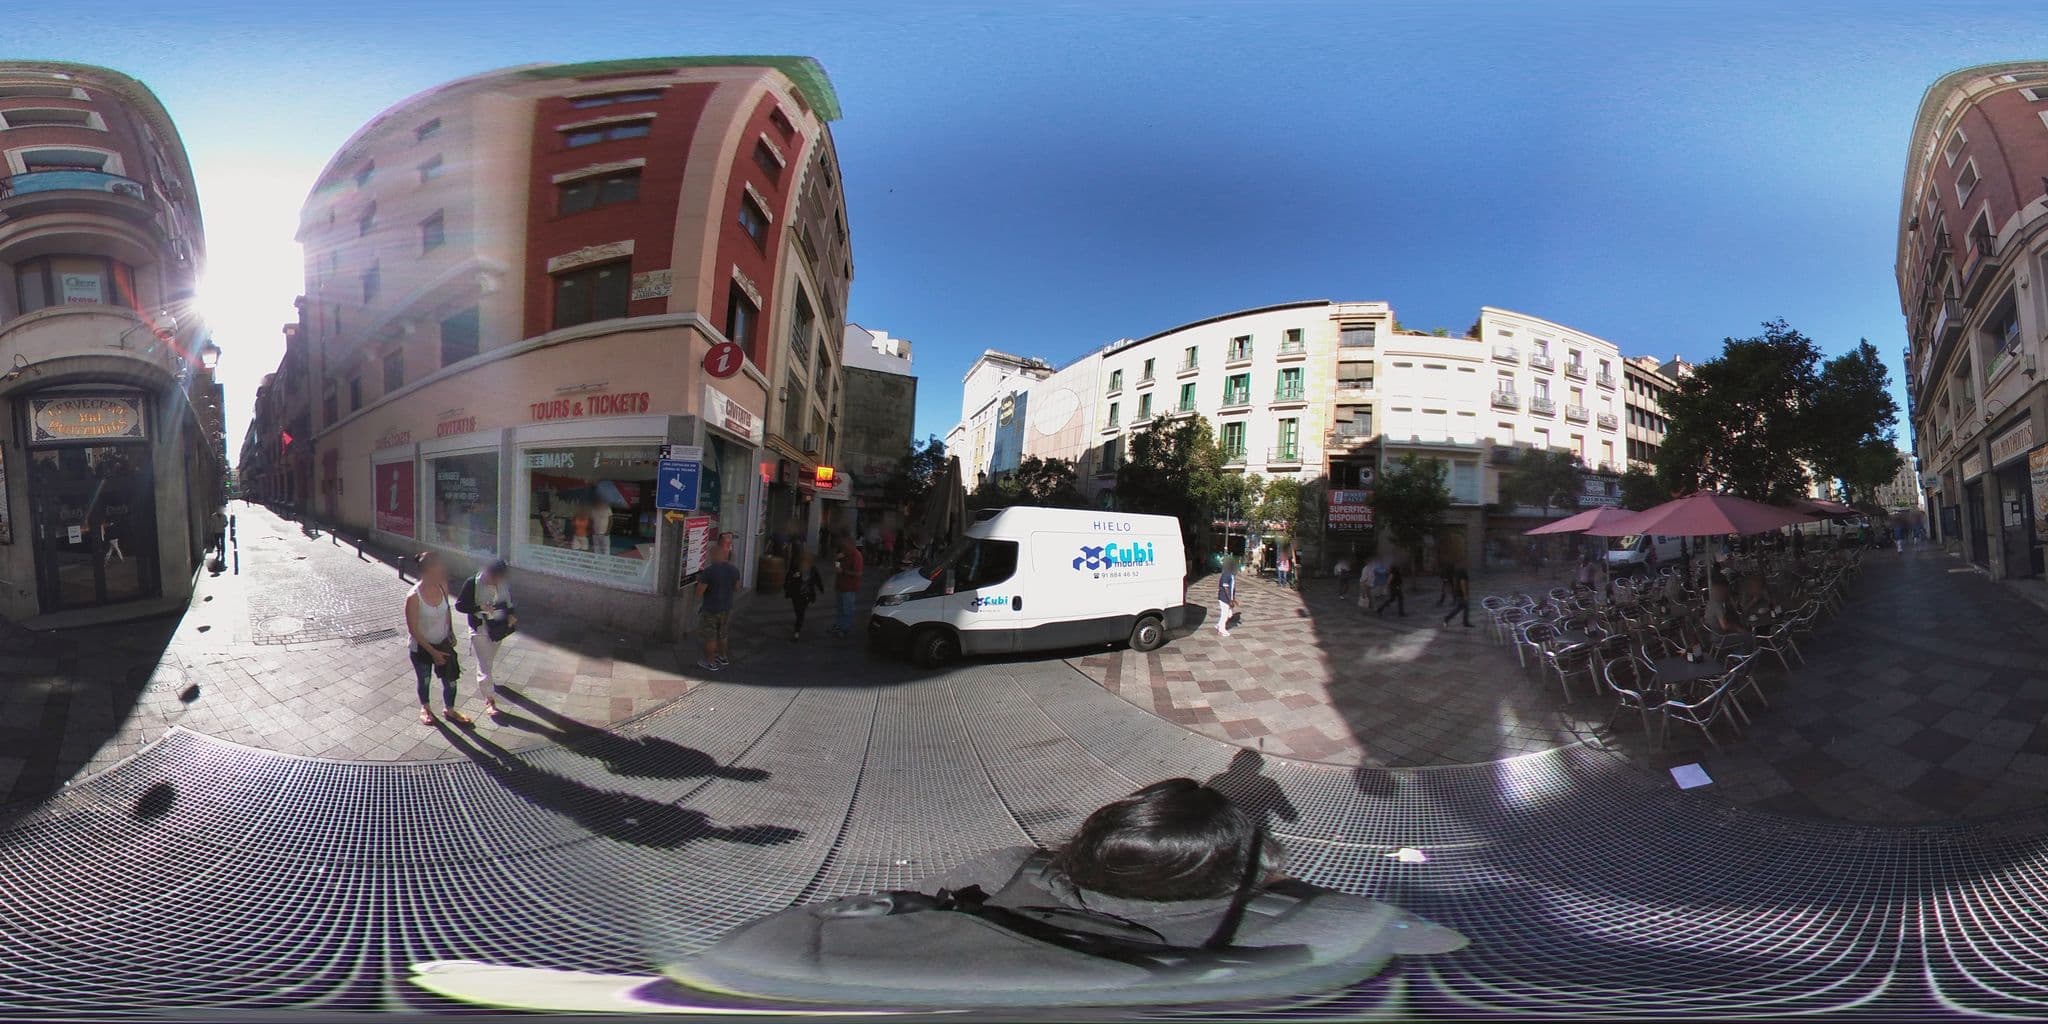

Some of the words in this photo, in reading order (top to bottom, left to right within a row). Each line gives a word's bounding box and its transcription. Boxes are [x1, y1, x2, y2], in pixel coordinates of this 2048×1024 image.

[530, 399, 570, 420] TOURS
[572, 402, 584, 417] &
[587, 392, 650, 415] TICKETS
[726, 399, 752, 428] CIVITATIS
[437, 416, 476, 438] CIVITATIS
[1329, 513, 1372, 522] DISPONIBLE
[1330, 505, 1372, 514] SUPERFICIE
[1093, 521, 1131, 532] HIELO
[1105, 542, 1153, 563] Cubi
[985, 595, 1008, 605] Cubi
